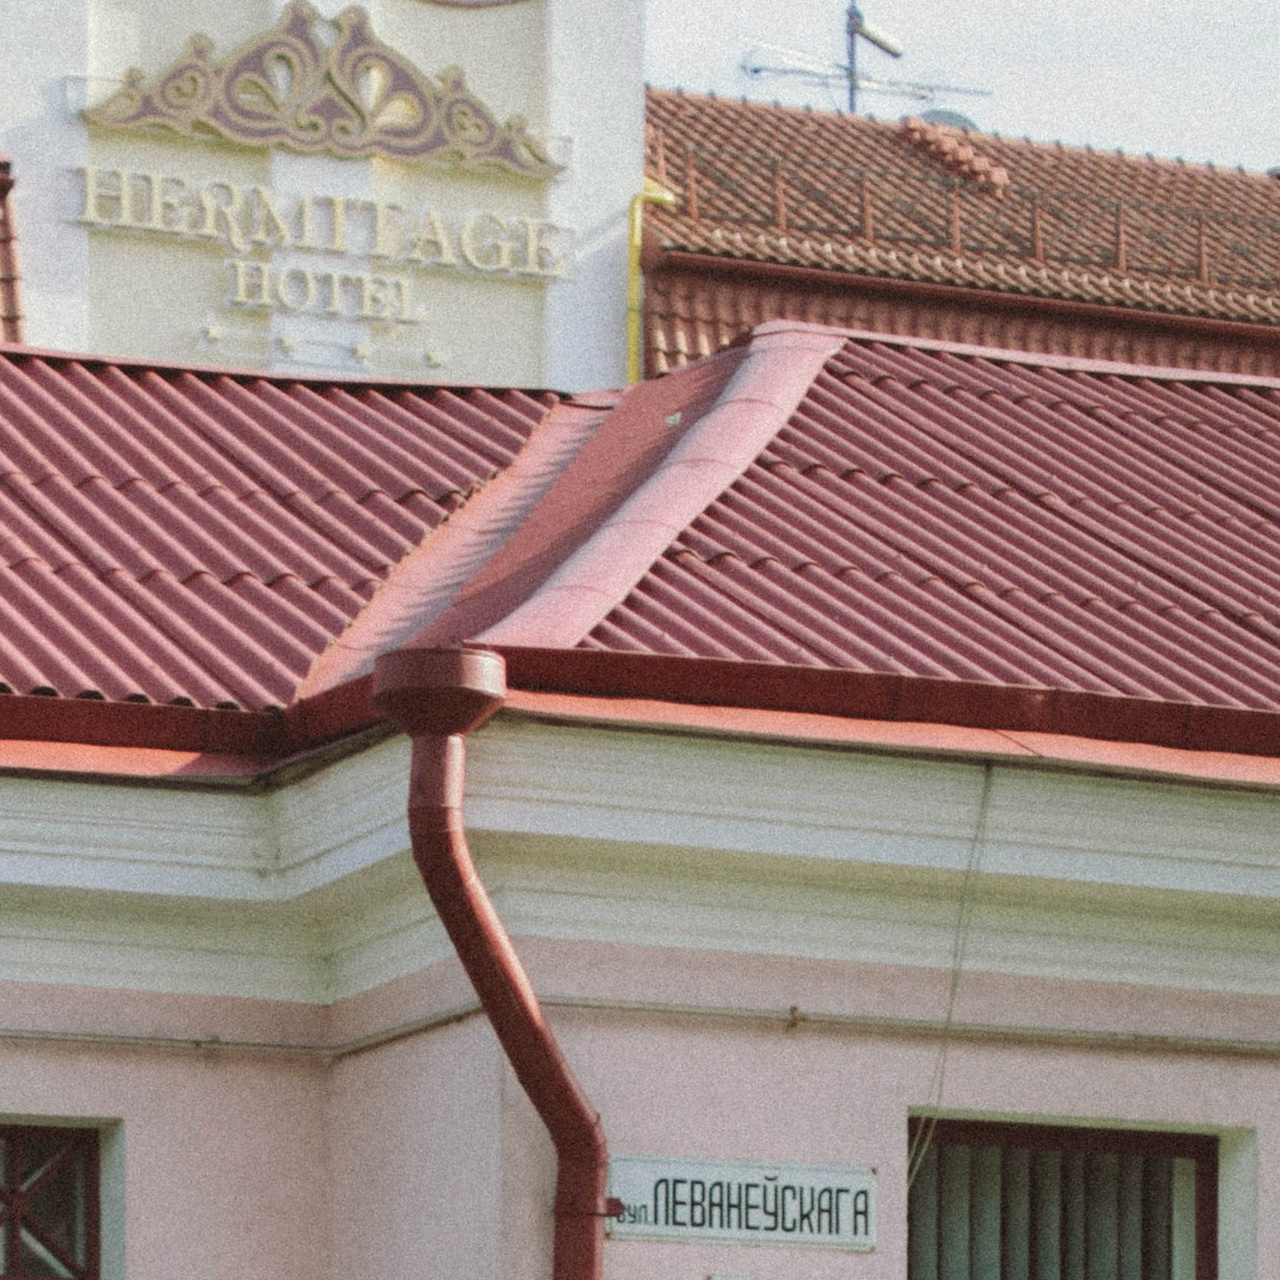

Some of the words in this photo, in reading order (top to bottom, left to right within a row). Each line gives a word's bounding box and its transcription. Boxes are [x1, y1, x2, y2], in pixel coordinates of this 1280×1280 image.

[80, 168, 567, 277] HERMITAGE
[231, 260, 425, 323] HOTEL
[653, 1175, 869, 1236] ЛЕВАНЕЎСКАГА
